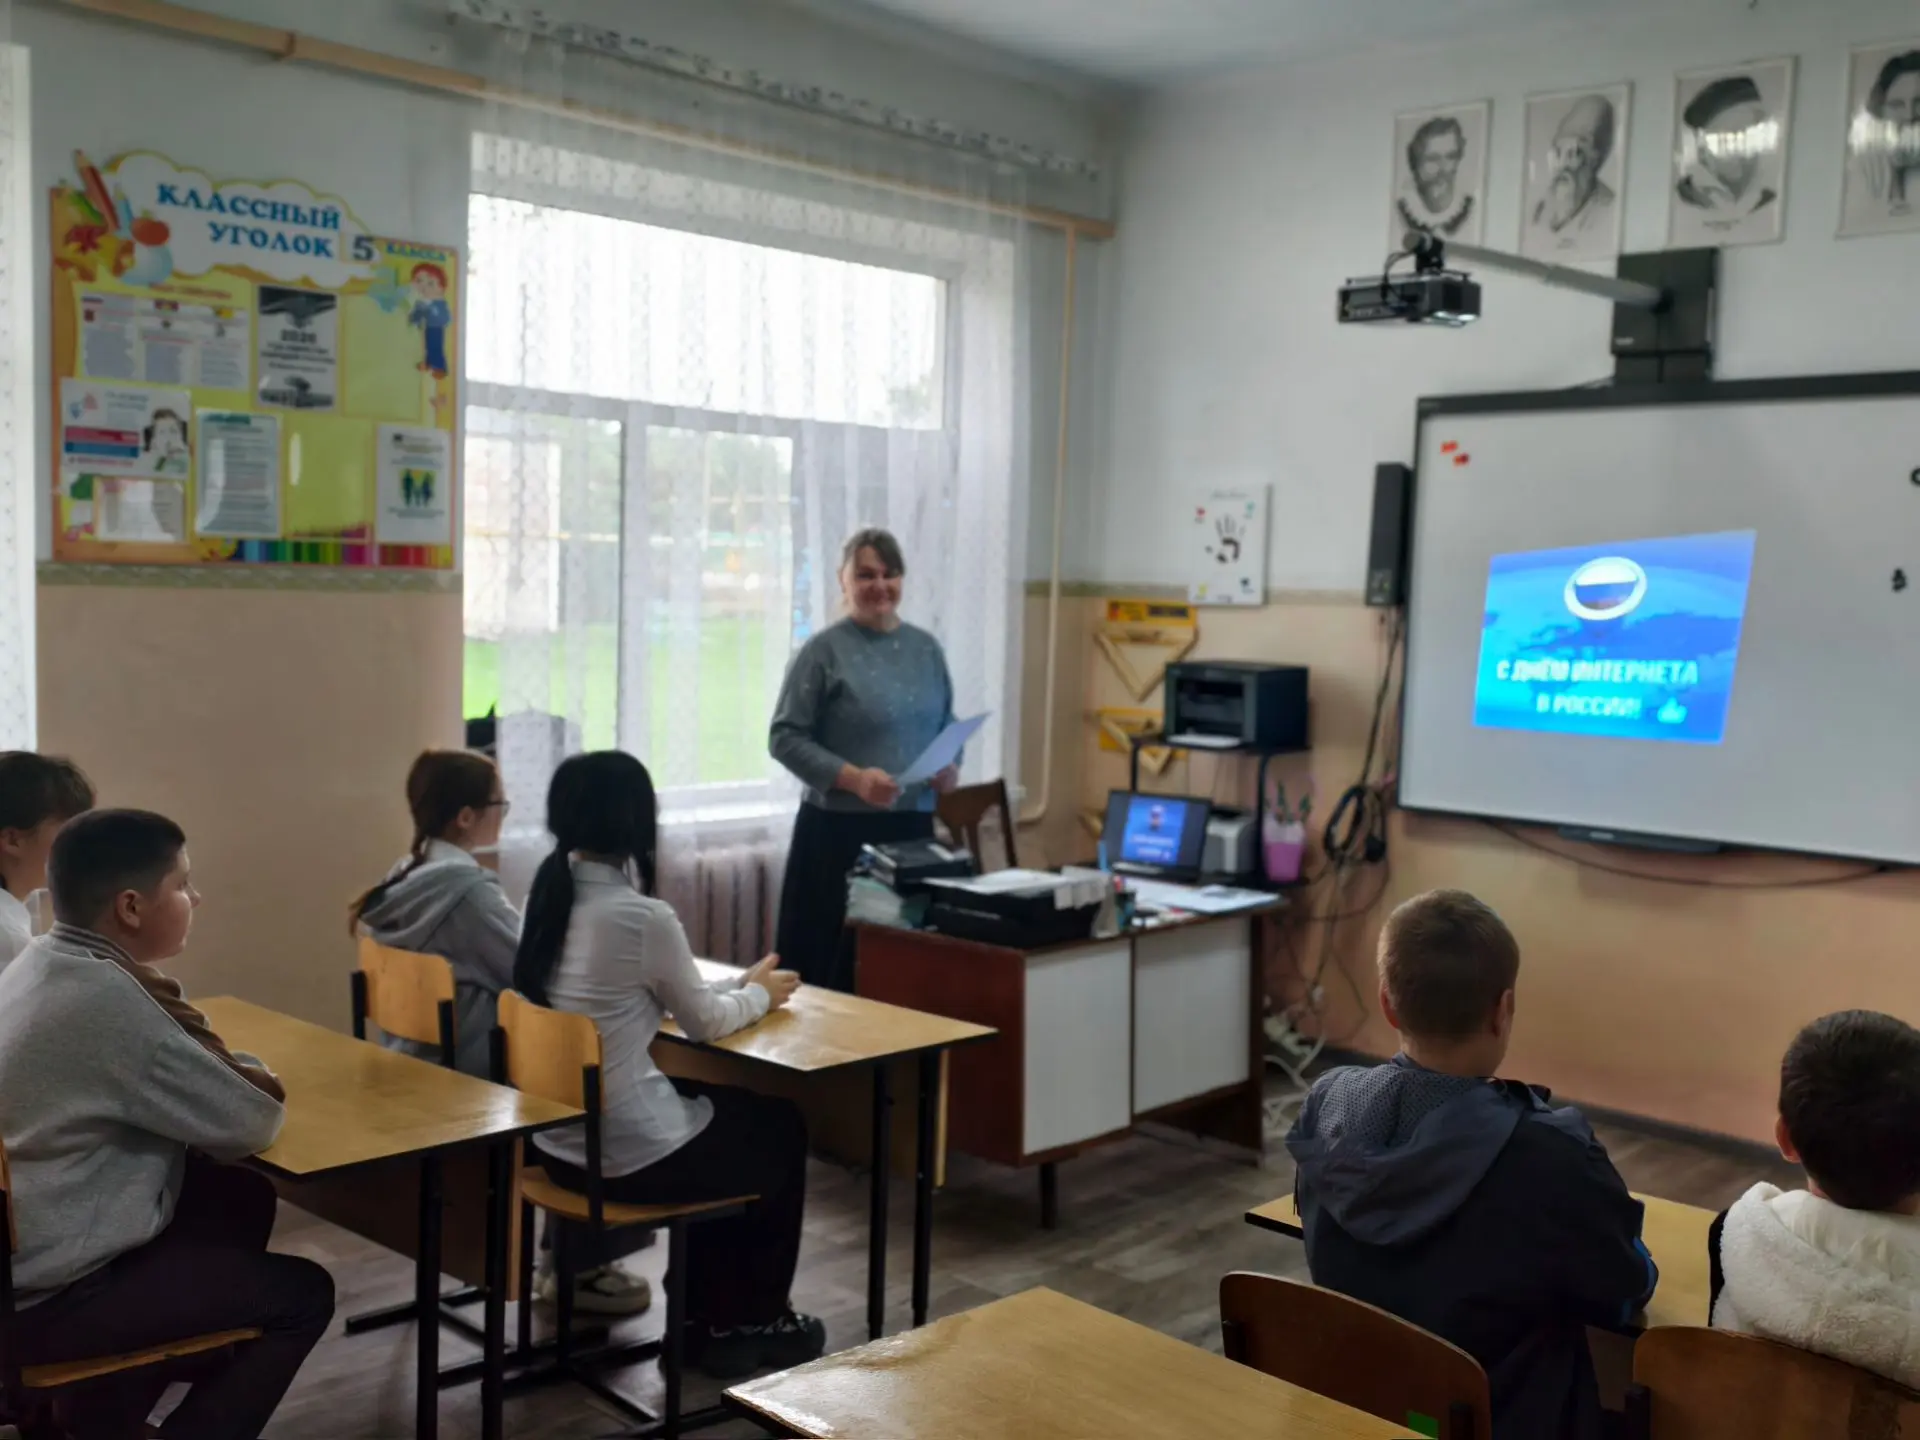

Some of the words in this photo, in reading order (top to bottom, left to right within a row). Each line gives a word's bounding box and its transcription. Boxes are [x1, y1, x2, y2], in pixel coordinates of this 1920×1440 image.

[157, 184, 341, 230] КЛАССНЫЙ
[208, 221, 334, 259] УГОЛОК
[353, 236, 375, 262] 5
[1497, 661, 1509, 680] С
[1571, 660, 1698, 684] ИНТЕРНЕТА
[1536, 693, 1550, 713] В
